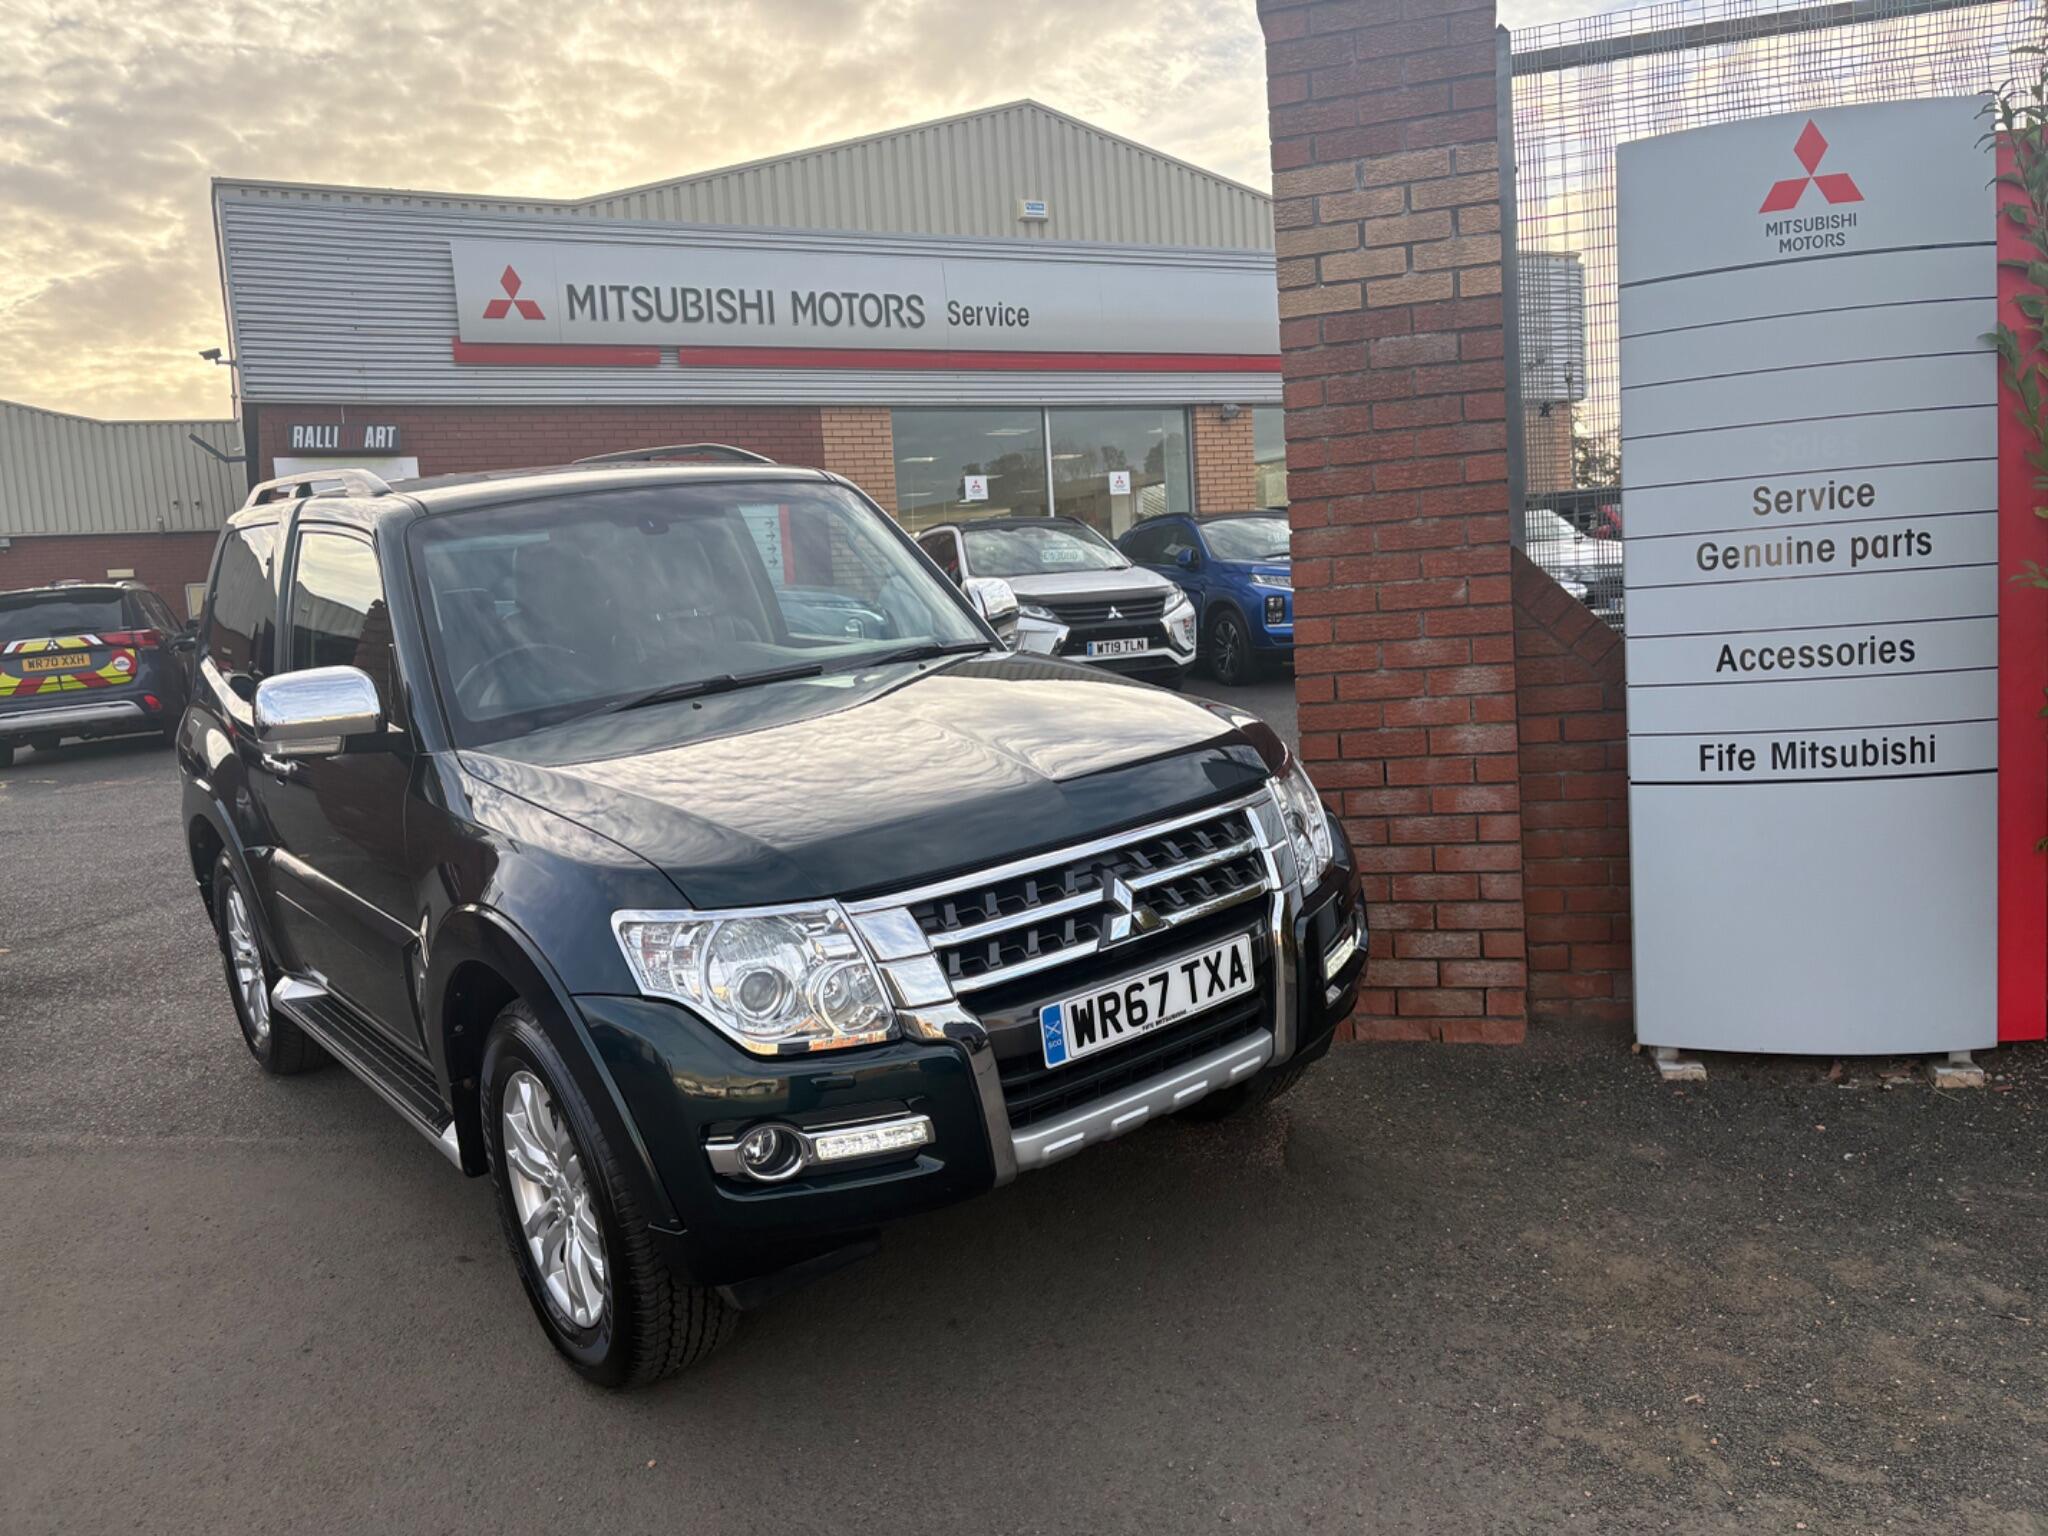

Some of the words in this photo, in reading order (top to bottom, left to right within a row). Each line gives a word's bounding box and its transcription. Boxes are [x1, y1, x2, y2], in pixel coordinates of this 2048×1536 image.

[1765, 212, 1857, 237] MITSUBISHI
[1779, 232, 1846, 253] MOTORS
[566, 283, 775, 325] MITSUBISHI
[790, 290, 926, 329] MOTORS
[947, 299, 1030, 327] Service
[1752, 480, 1875, 516] Service
[1696, 536, 1836, 571] Genuine
[1851, 528, 1933, 567] parts
[28, 657, 58, 669] WR70
[62, 655, 84, 666] XXH
[1097, 641, 1121, 653] WT19
[1123, 639, 1144, 651] TLN
[1715, 635, 1916, 673] Accessories
[1699, 743, 1756, 772] Fife
[1771, 734, 1936, 770] Mitsubishi
[1071, 971, 1169, 1048] WR67
[1181, 944, 1247, 1004] TXA
